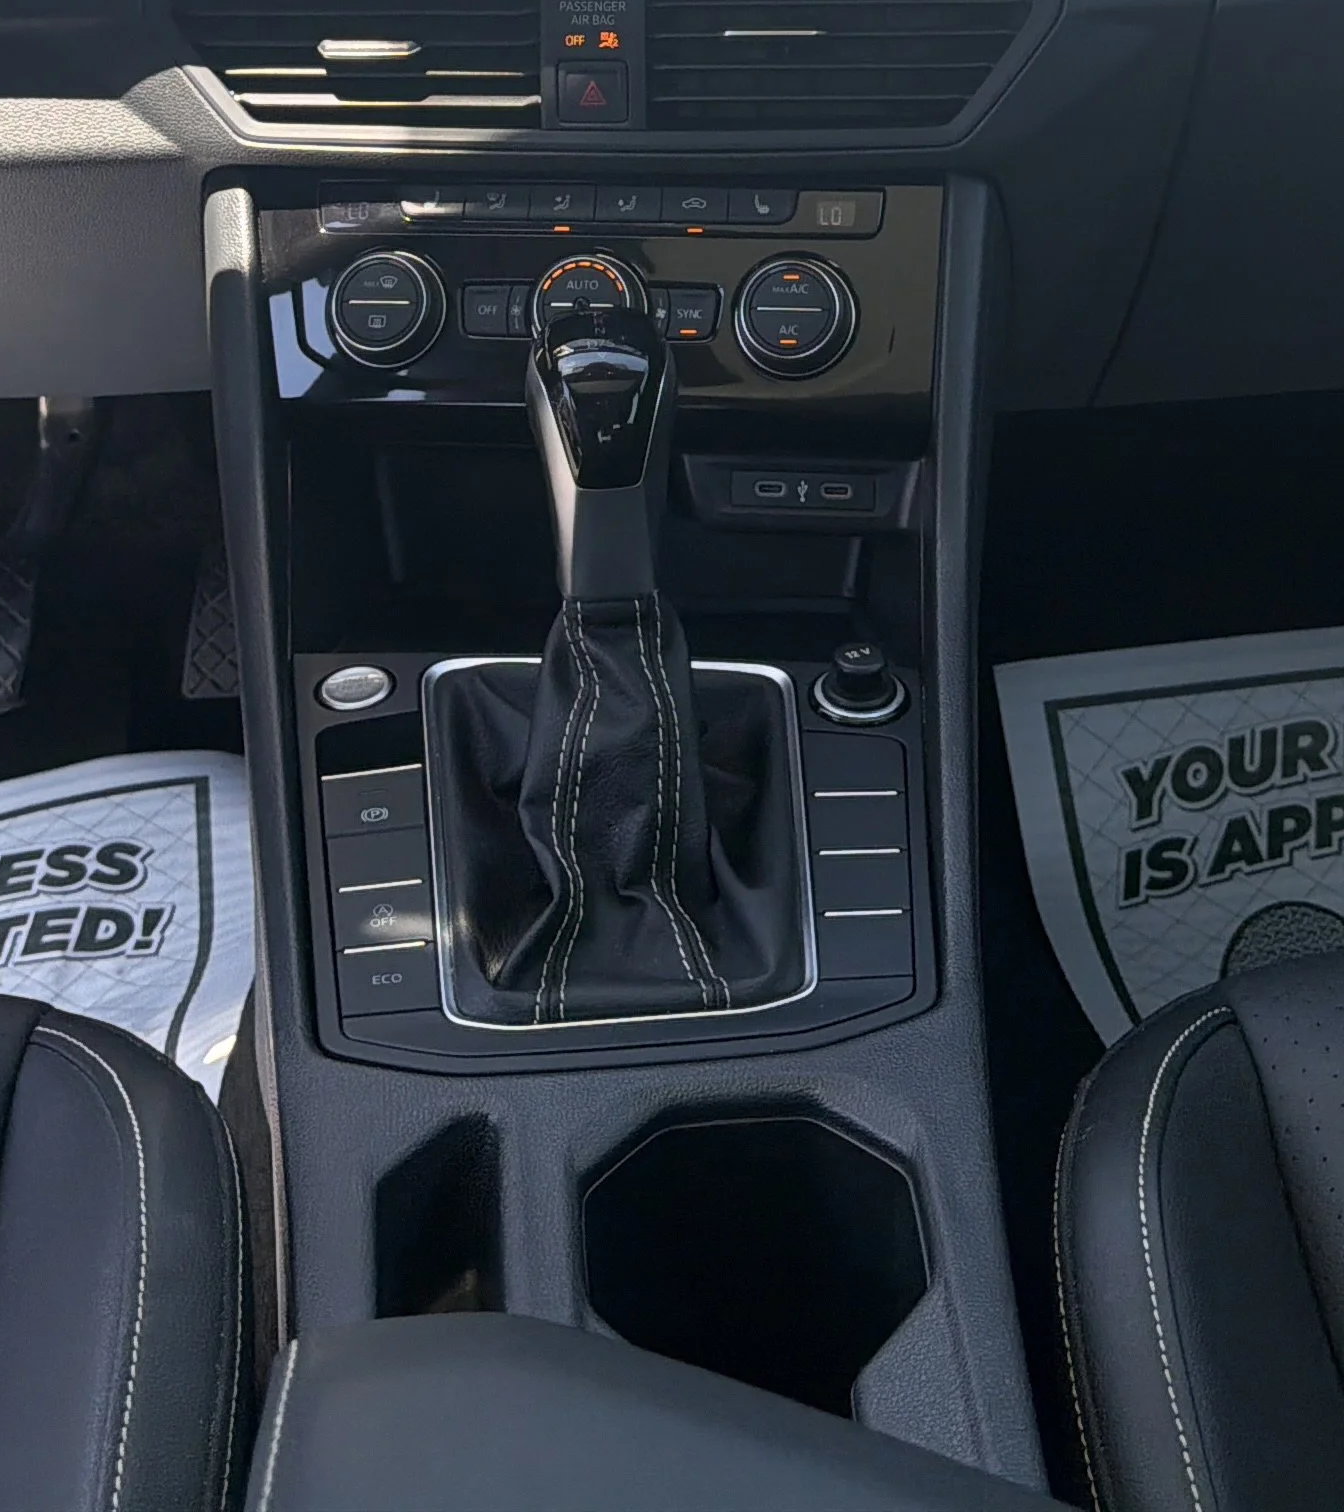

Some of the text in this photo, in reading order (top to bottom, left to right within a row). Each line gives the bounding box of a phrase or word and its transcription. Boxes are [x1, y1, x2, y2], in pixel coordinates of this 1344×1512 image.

[559, 1, 626, 12] PASSENGER
[571, 14, 615, 26] AIR BAG
[565, 34, 586, 47] OFF
[567, 280, 599, 290] AUTO
[790, 284, 809, 294] A/C
[478, 305, 498, 316] OFF
[677, 308, 702, 320] SYNC
[779, 324, 800, 336] A/C
[1120, 724, 1332, 823] YOUR
[1124, 839, 1190, 901] IS
[370, 916, 397, 928] OFF
[372, 973, 403, 985] ECO
